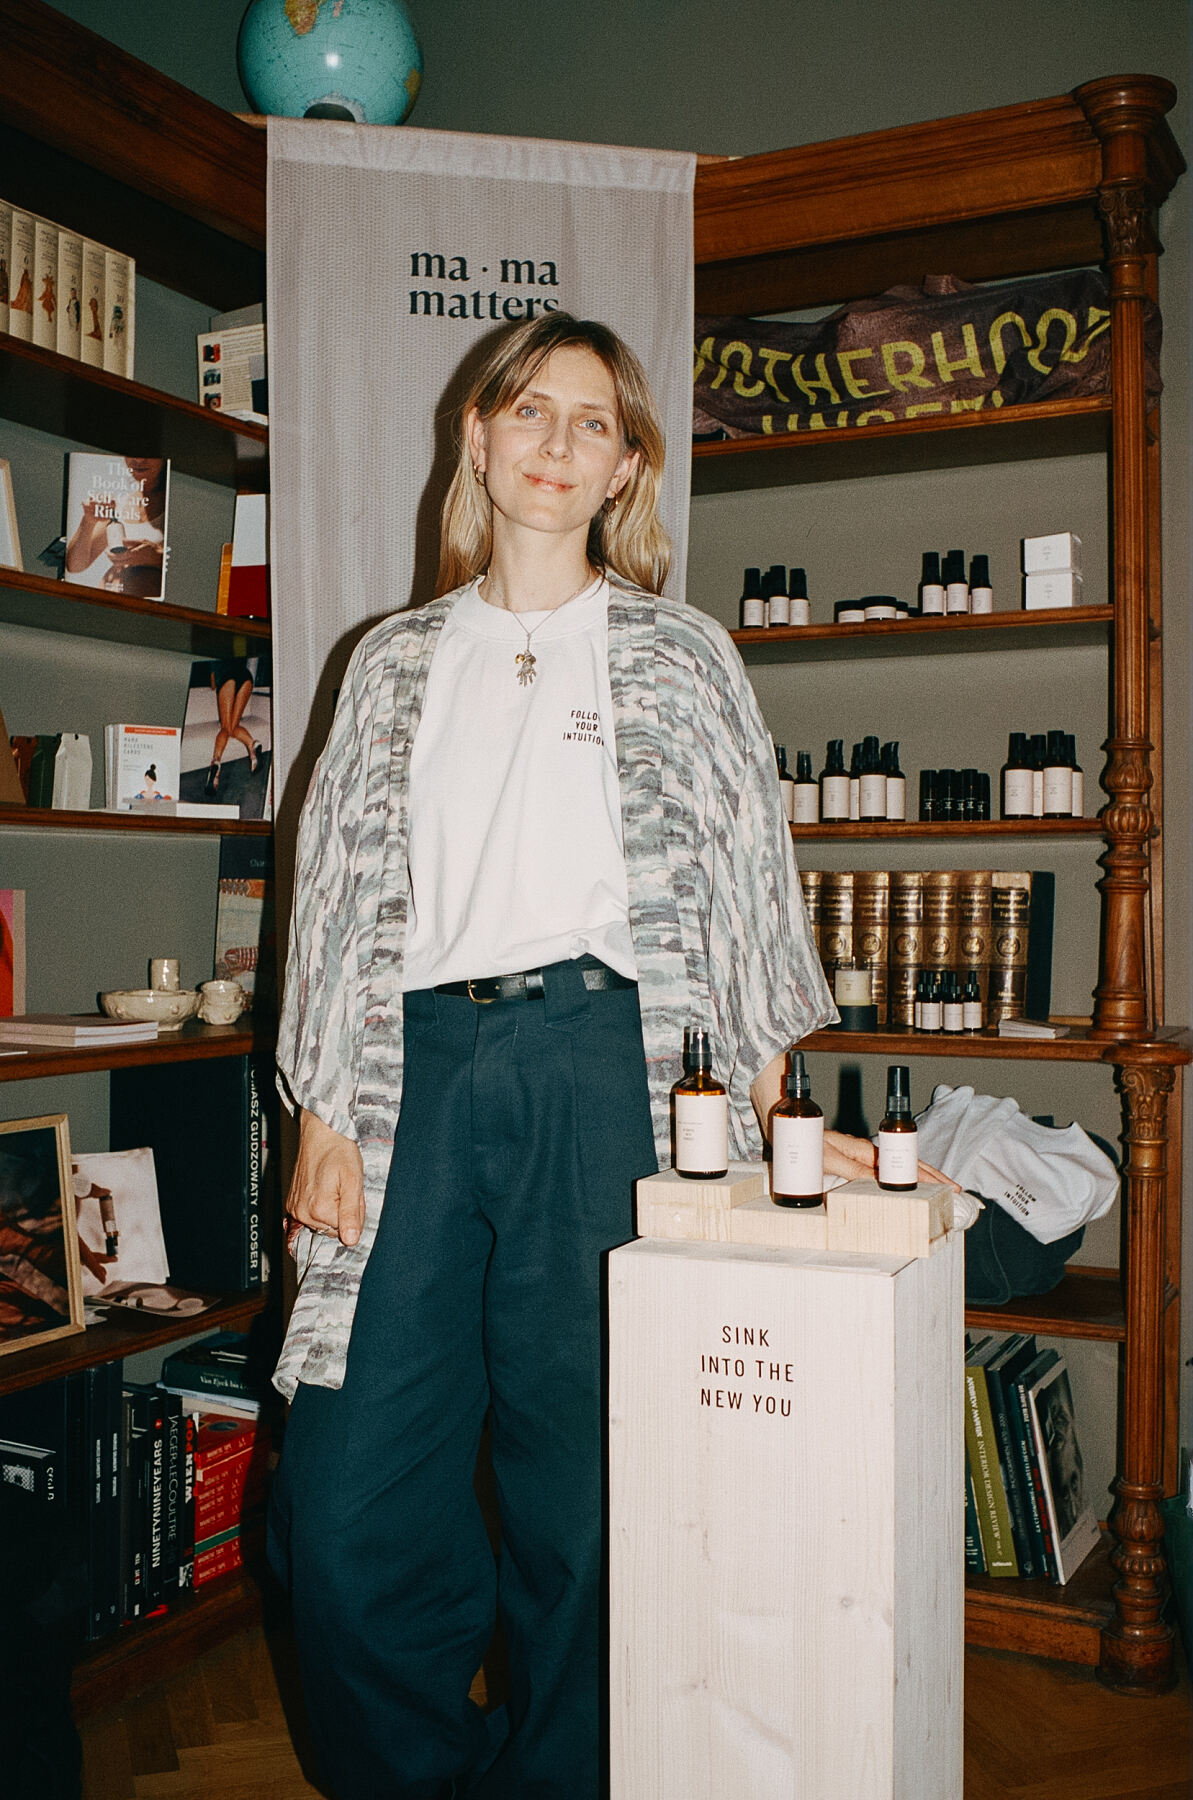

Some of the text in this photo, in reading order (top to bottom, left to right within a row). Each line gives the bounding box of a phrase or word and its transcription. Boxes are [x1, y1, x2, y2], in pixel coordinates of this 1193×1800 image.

[410, 252, 470, 281] ma
[500, 259, 560, 286] ma
[92, 475, 147, 492] Book of
[107, 461, 134, 477] The
[94, 504, 141, 519] Rituals
[570, 710, 599, 721] FOLLO
[576, 721, 598, 732] YOUR
[250, 1121, 259, 1206] GUDZOWATY
[1004, 1191, 1030, 1216] INTUITION
[1016, 1191, 1029, 1205] YOUR
[250, 1213, 259, 1269] CLOSER
[722, 1325, 770, 1347] SINK
[701, 1354, 794, 1383] INTO THE
[700, 1388, 791, 1417] NEW YOU
[977, 1440, 991, 1479] INTERIOR
[152, 1439, 163, 1568] NINETYNINEYEARS
[984, 1479, 996, 1510] DESIGN
[989, 1510, 1000, 1541] REVIEW
